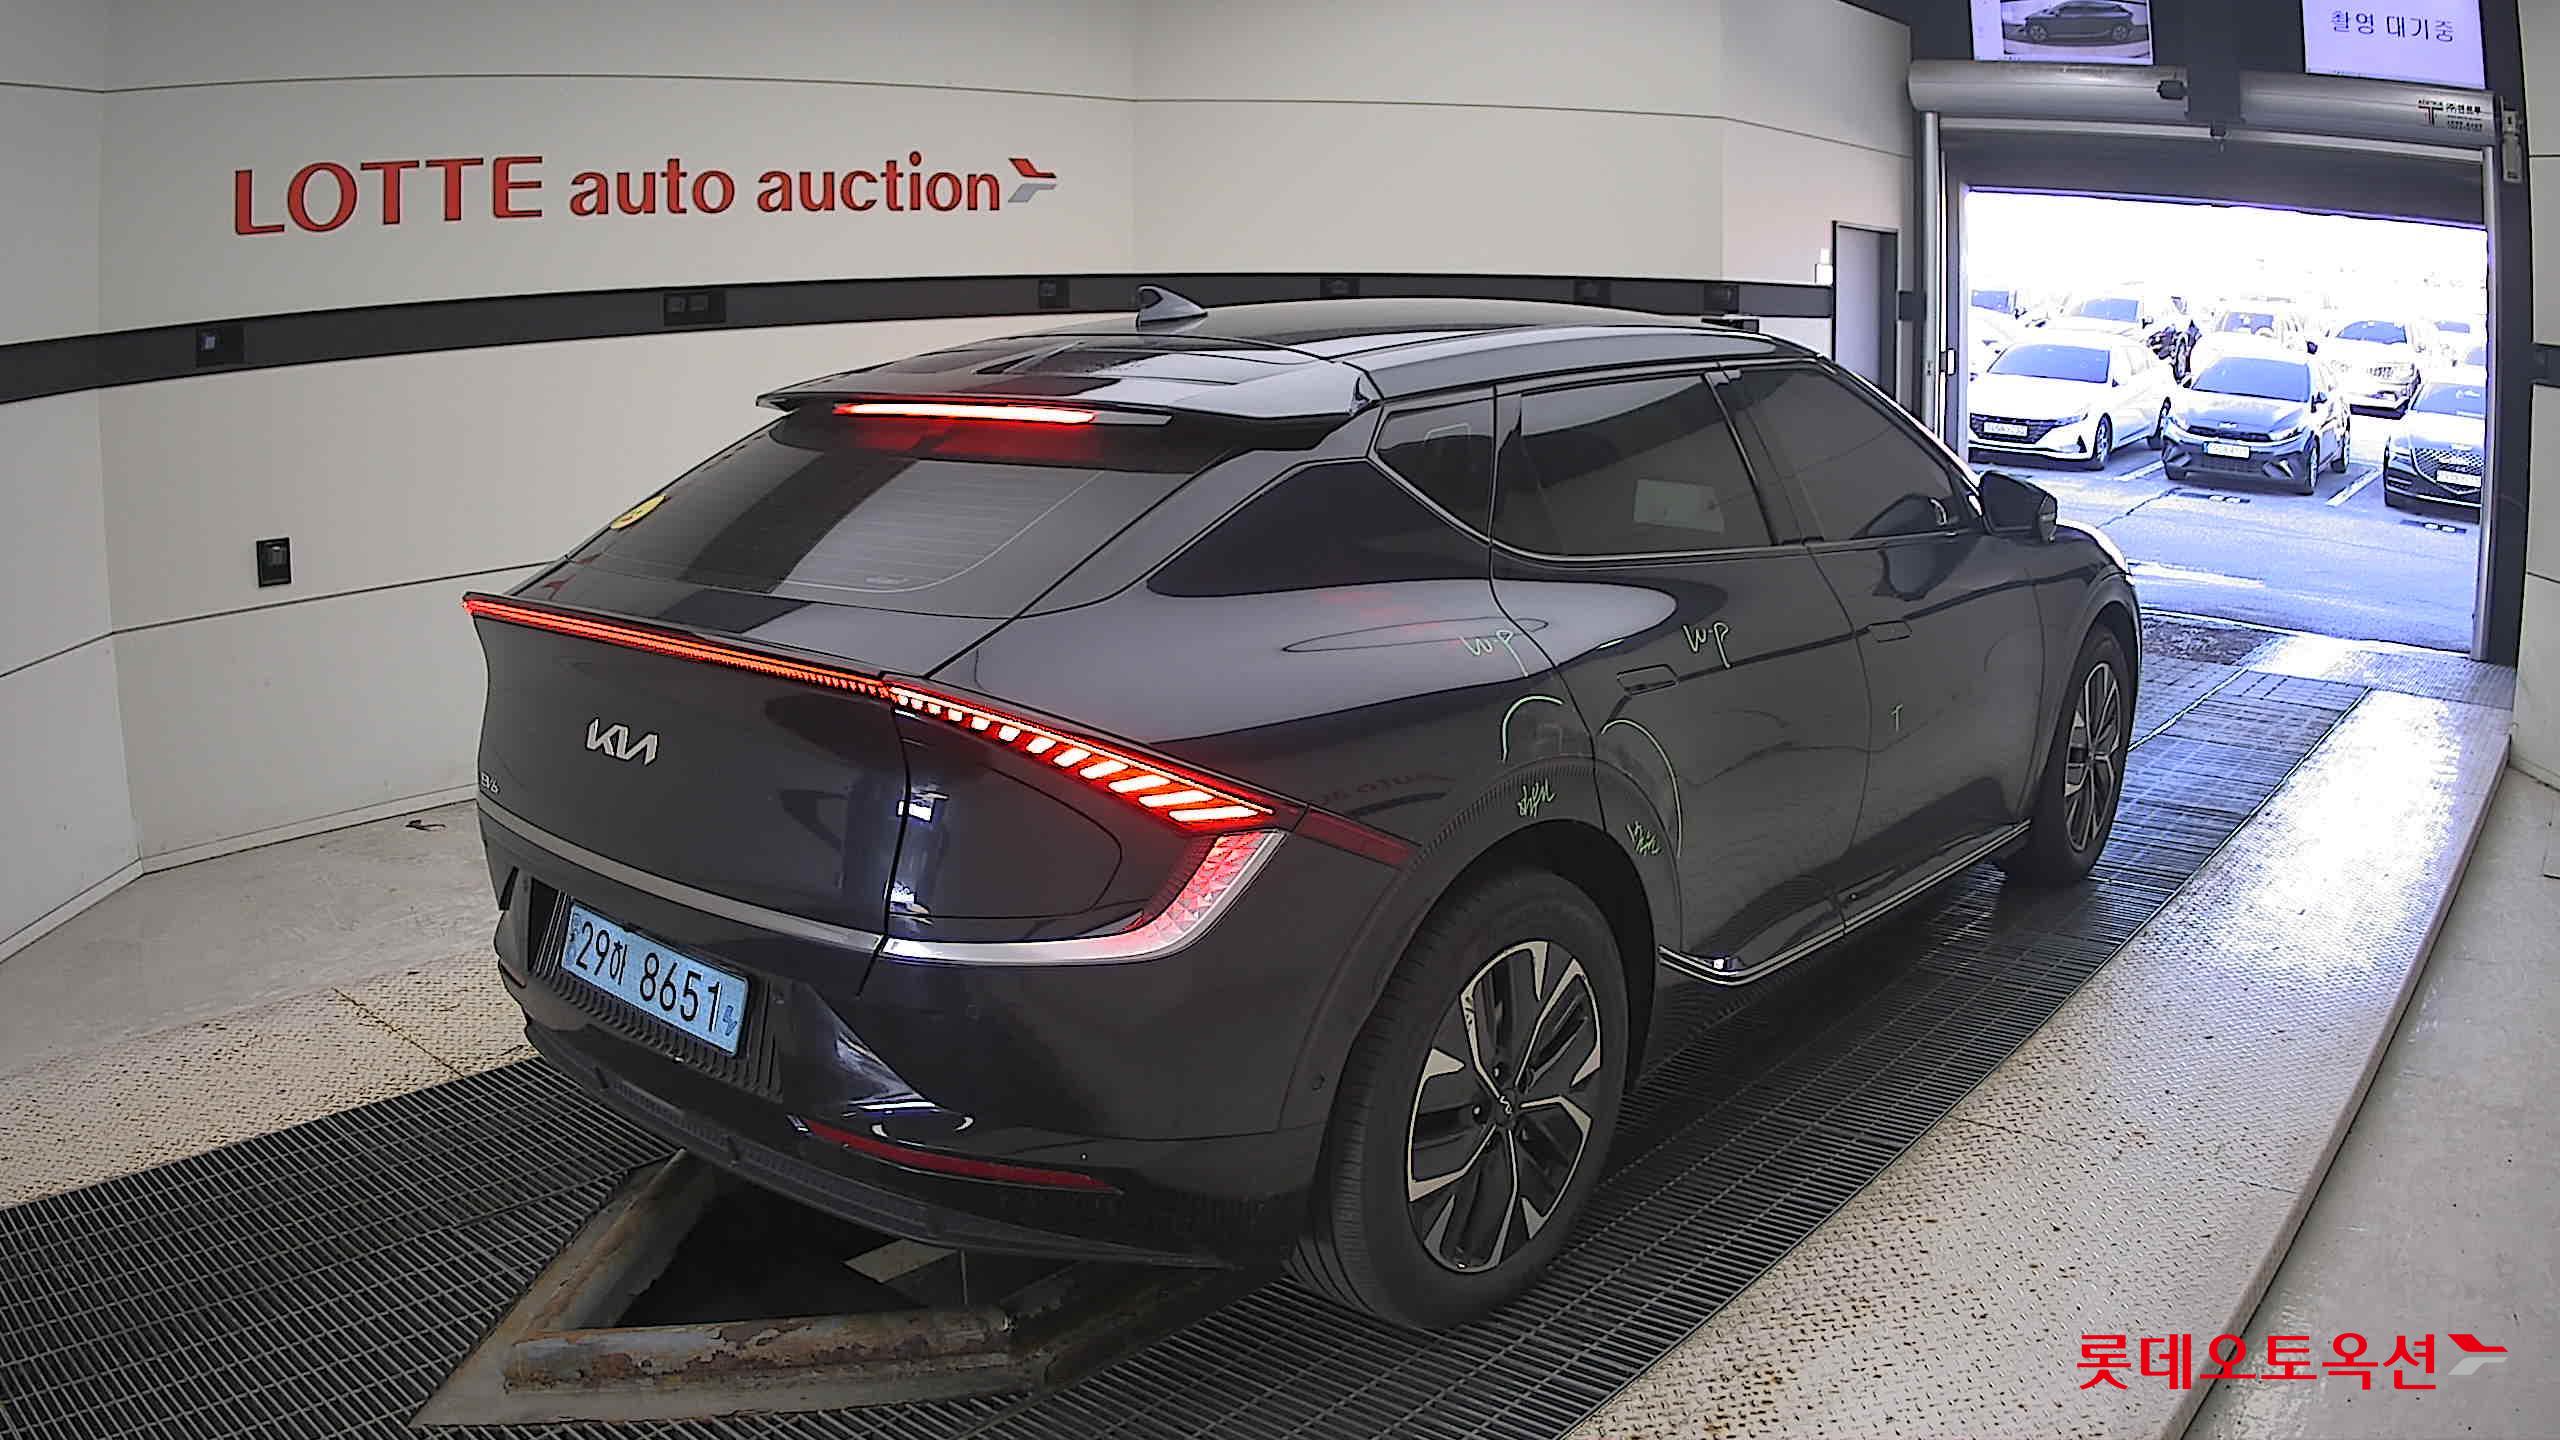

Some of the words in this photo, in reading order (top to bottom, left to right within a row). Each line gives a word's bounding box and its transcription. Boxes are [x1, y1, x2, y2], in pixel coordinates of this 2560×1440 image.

[234, 155, 543, 236] LOTTE
[569, 157, 735, 217] auto
[757, 150, 1001, 212] auction
[585, 717, 660, 767] KIA
[575, 921, 628, 985] 29하
[639, 952, 722, 1033] 8651
